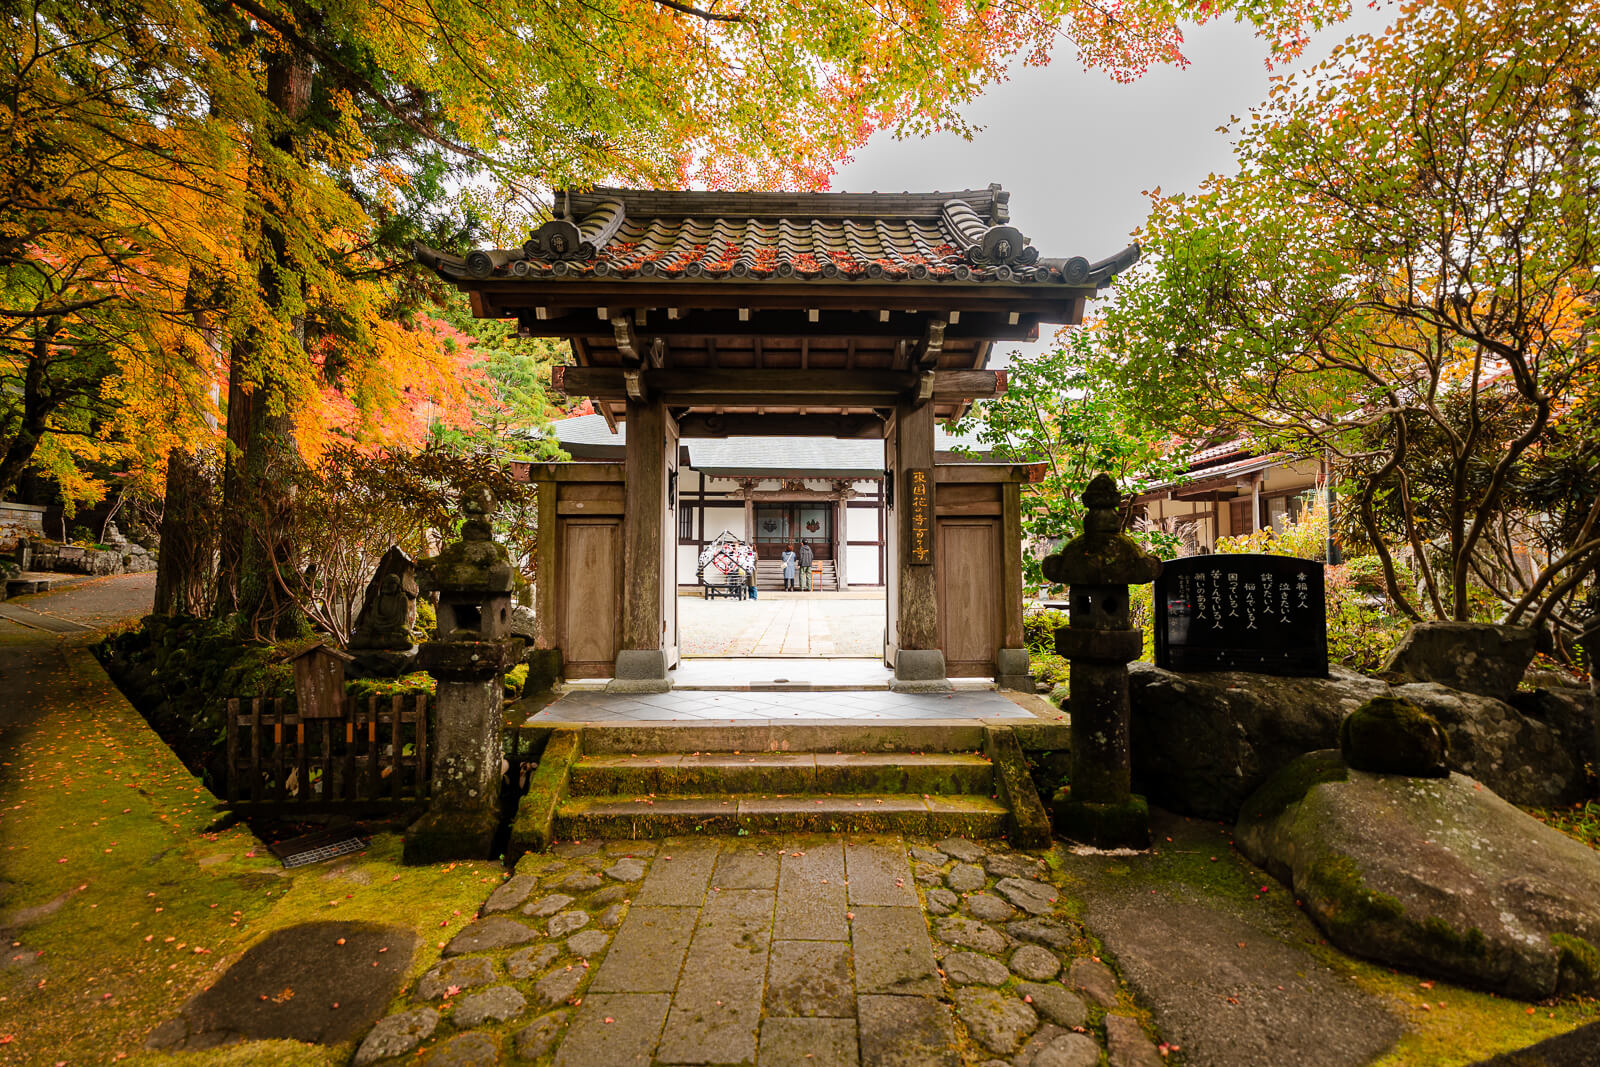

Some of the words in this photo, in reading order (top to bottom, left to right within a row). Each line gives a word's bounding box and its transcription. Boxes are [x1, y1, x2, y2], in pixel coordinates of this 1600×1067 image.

[1194, 573, 1206, 620] 願いのある人
[1210, 569, 1223, 629] 苦しんでいる人
[1228, 573, 1239, 618] 困っている人
[1244, 583, 1257, 630] 悩んでいる人
[1260, 573, 1275, 614] 詫びたい人
[1279, 583, 1292, 624] 泣きたい人
[1295, 572, 1309, 609] 幸福な人
